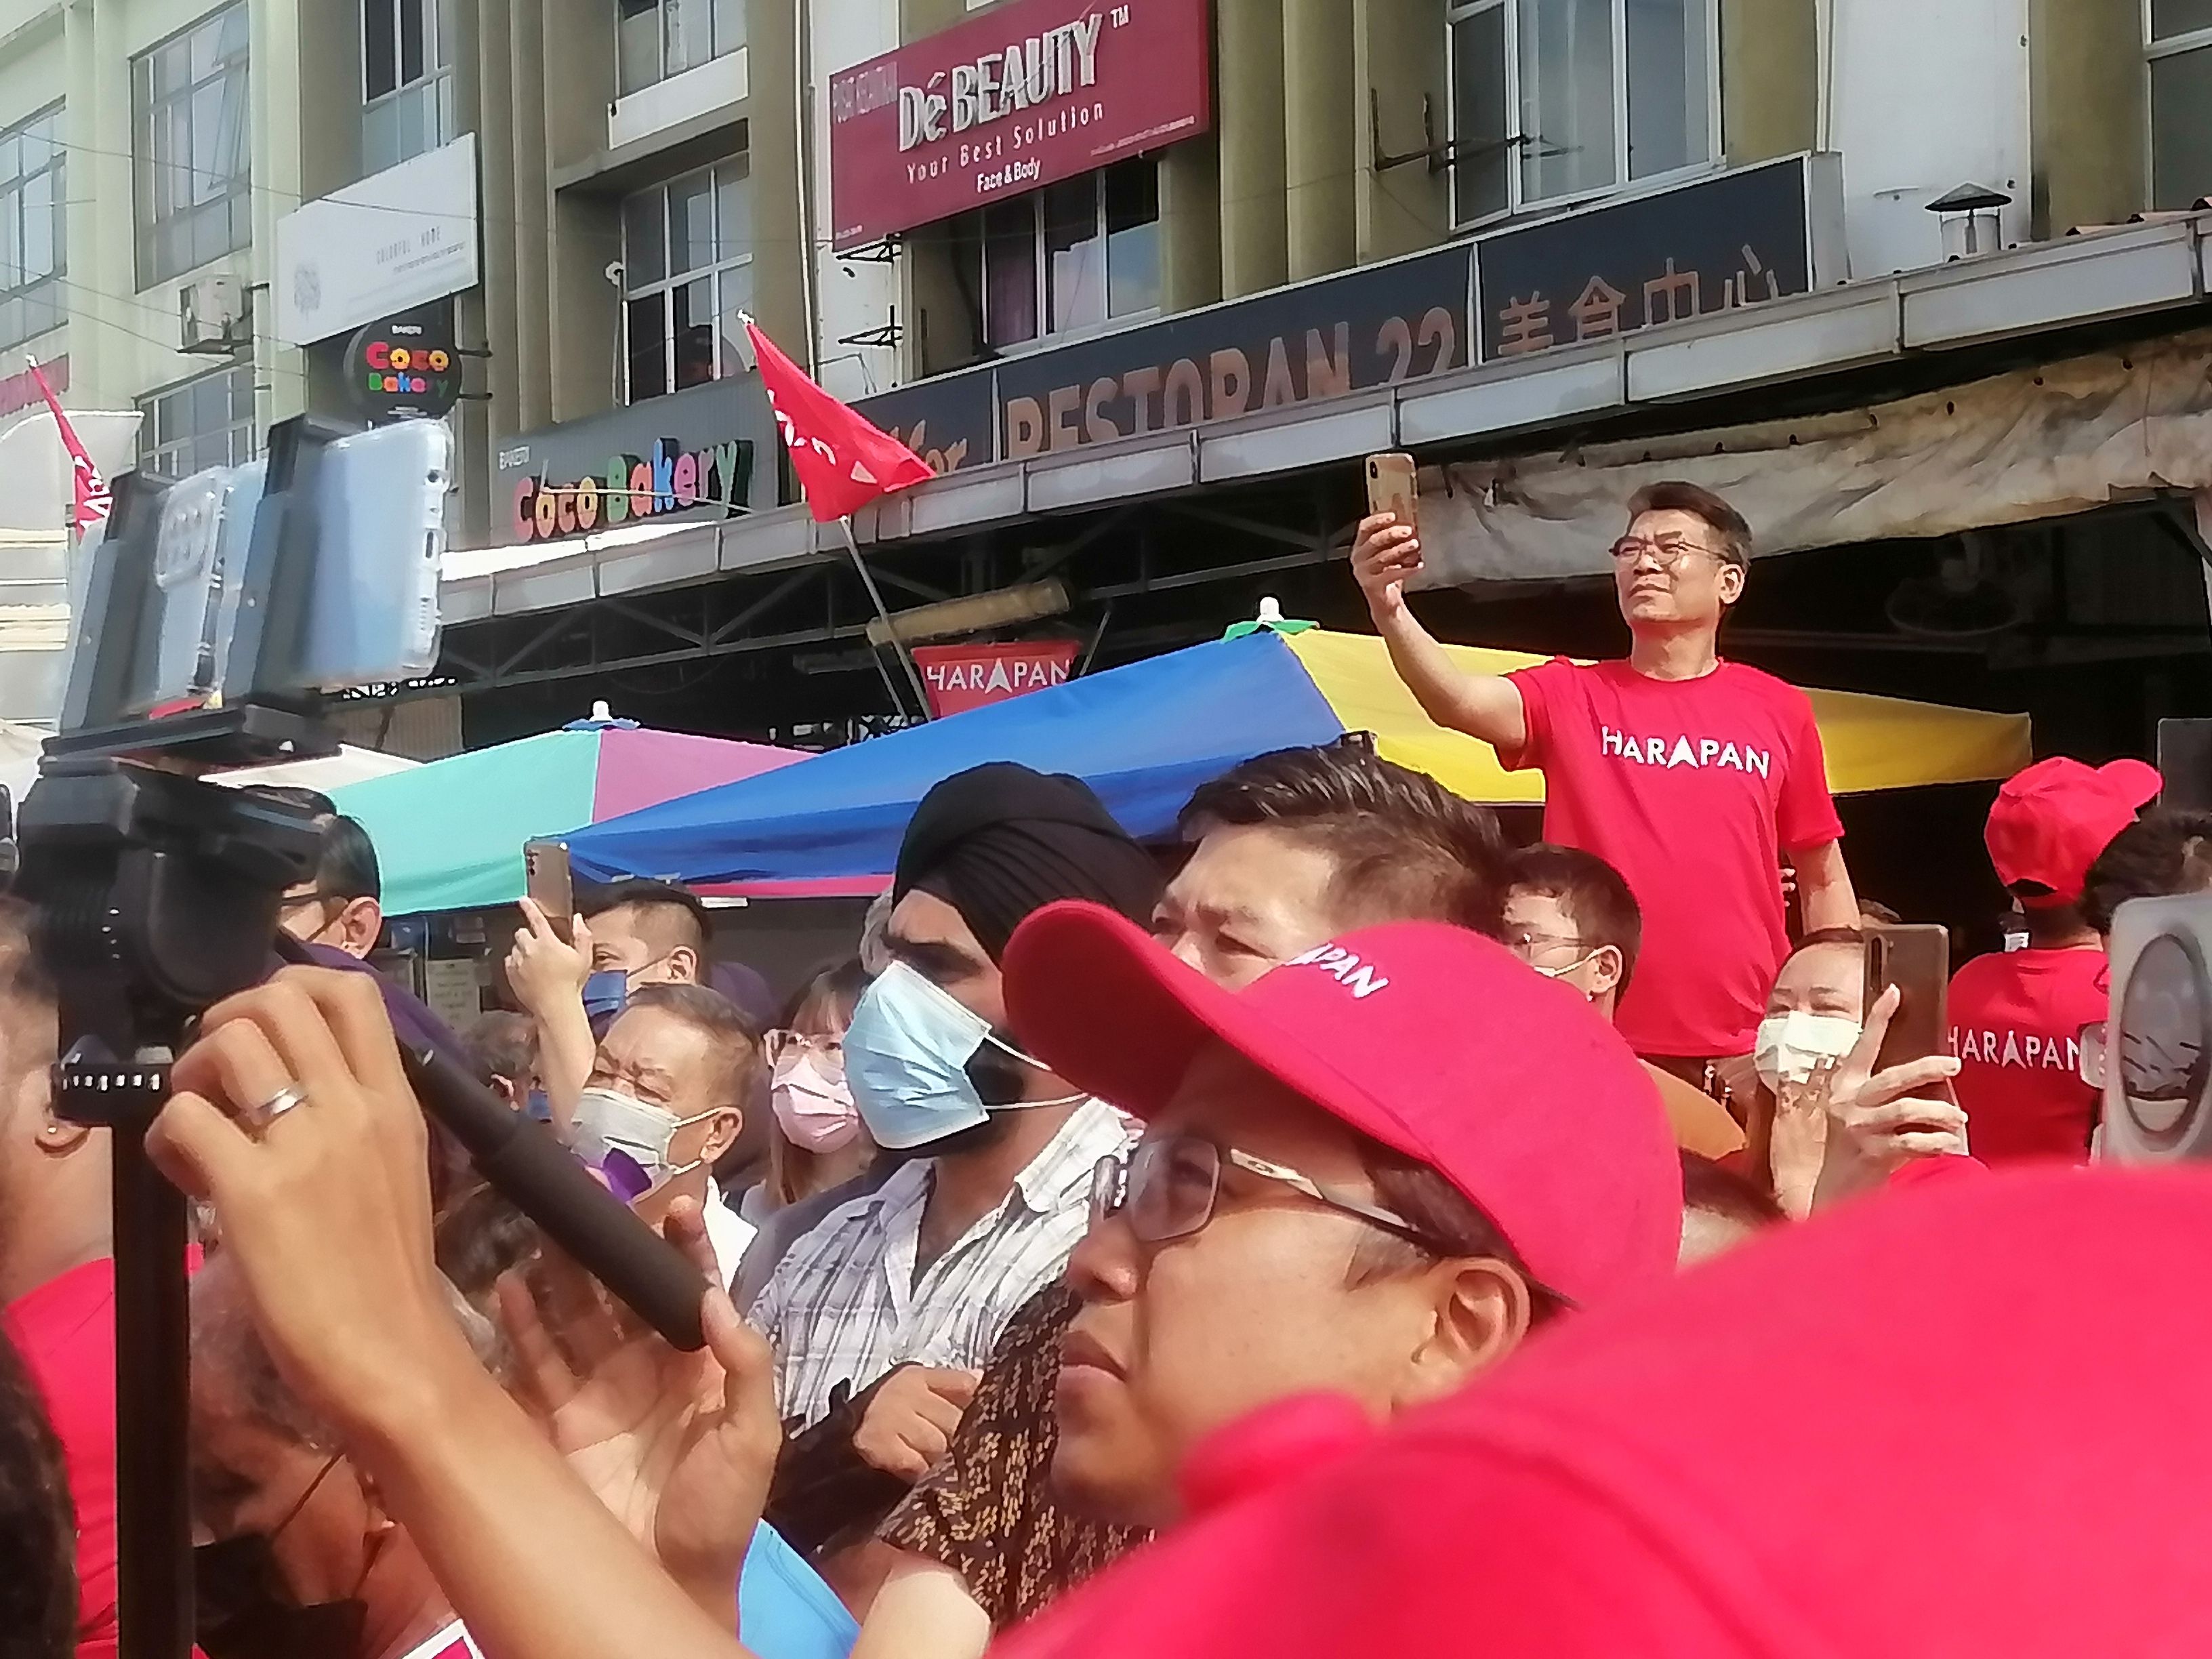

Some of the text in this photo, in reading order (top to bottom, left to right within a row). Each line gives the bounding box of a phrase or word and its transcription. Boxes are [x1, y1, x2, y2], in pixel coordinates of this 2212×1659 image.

[899, 71, 947, 152] Dé
[951, 13, 1103, 133] BEAUTY
[906, 156, 948, 184] Your
[960, 136, 1002, 167] Best
[1012, 103, 1103, 150] Solution
[1006, 321, 1353, 461] RESTORAN
[1375, 306, 1456, 384] 22
[514, 437, 737, 542] Coco Bakery
[926, 657, 1069, 695] HARAPAN
[1601, 725, 1769, 779] HARAPAN
